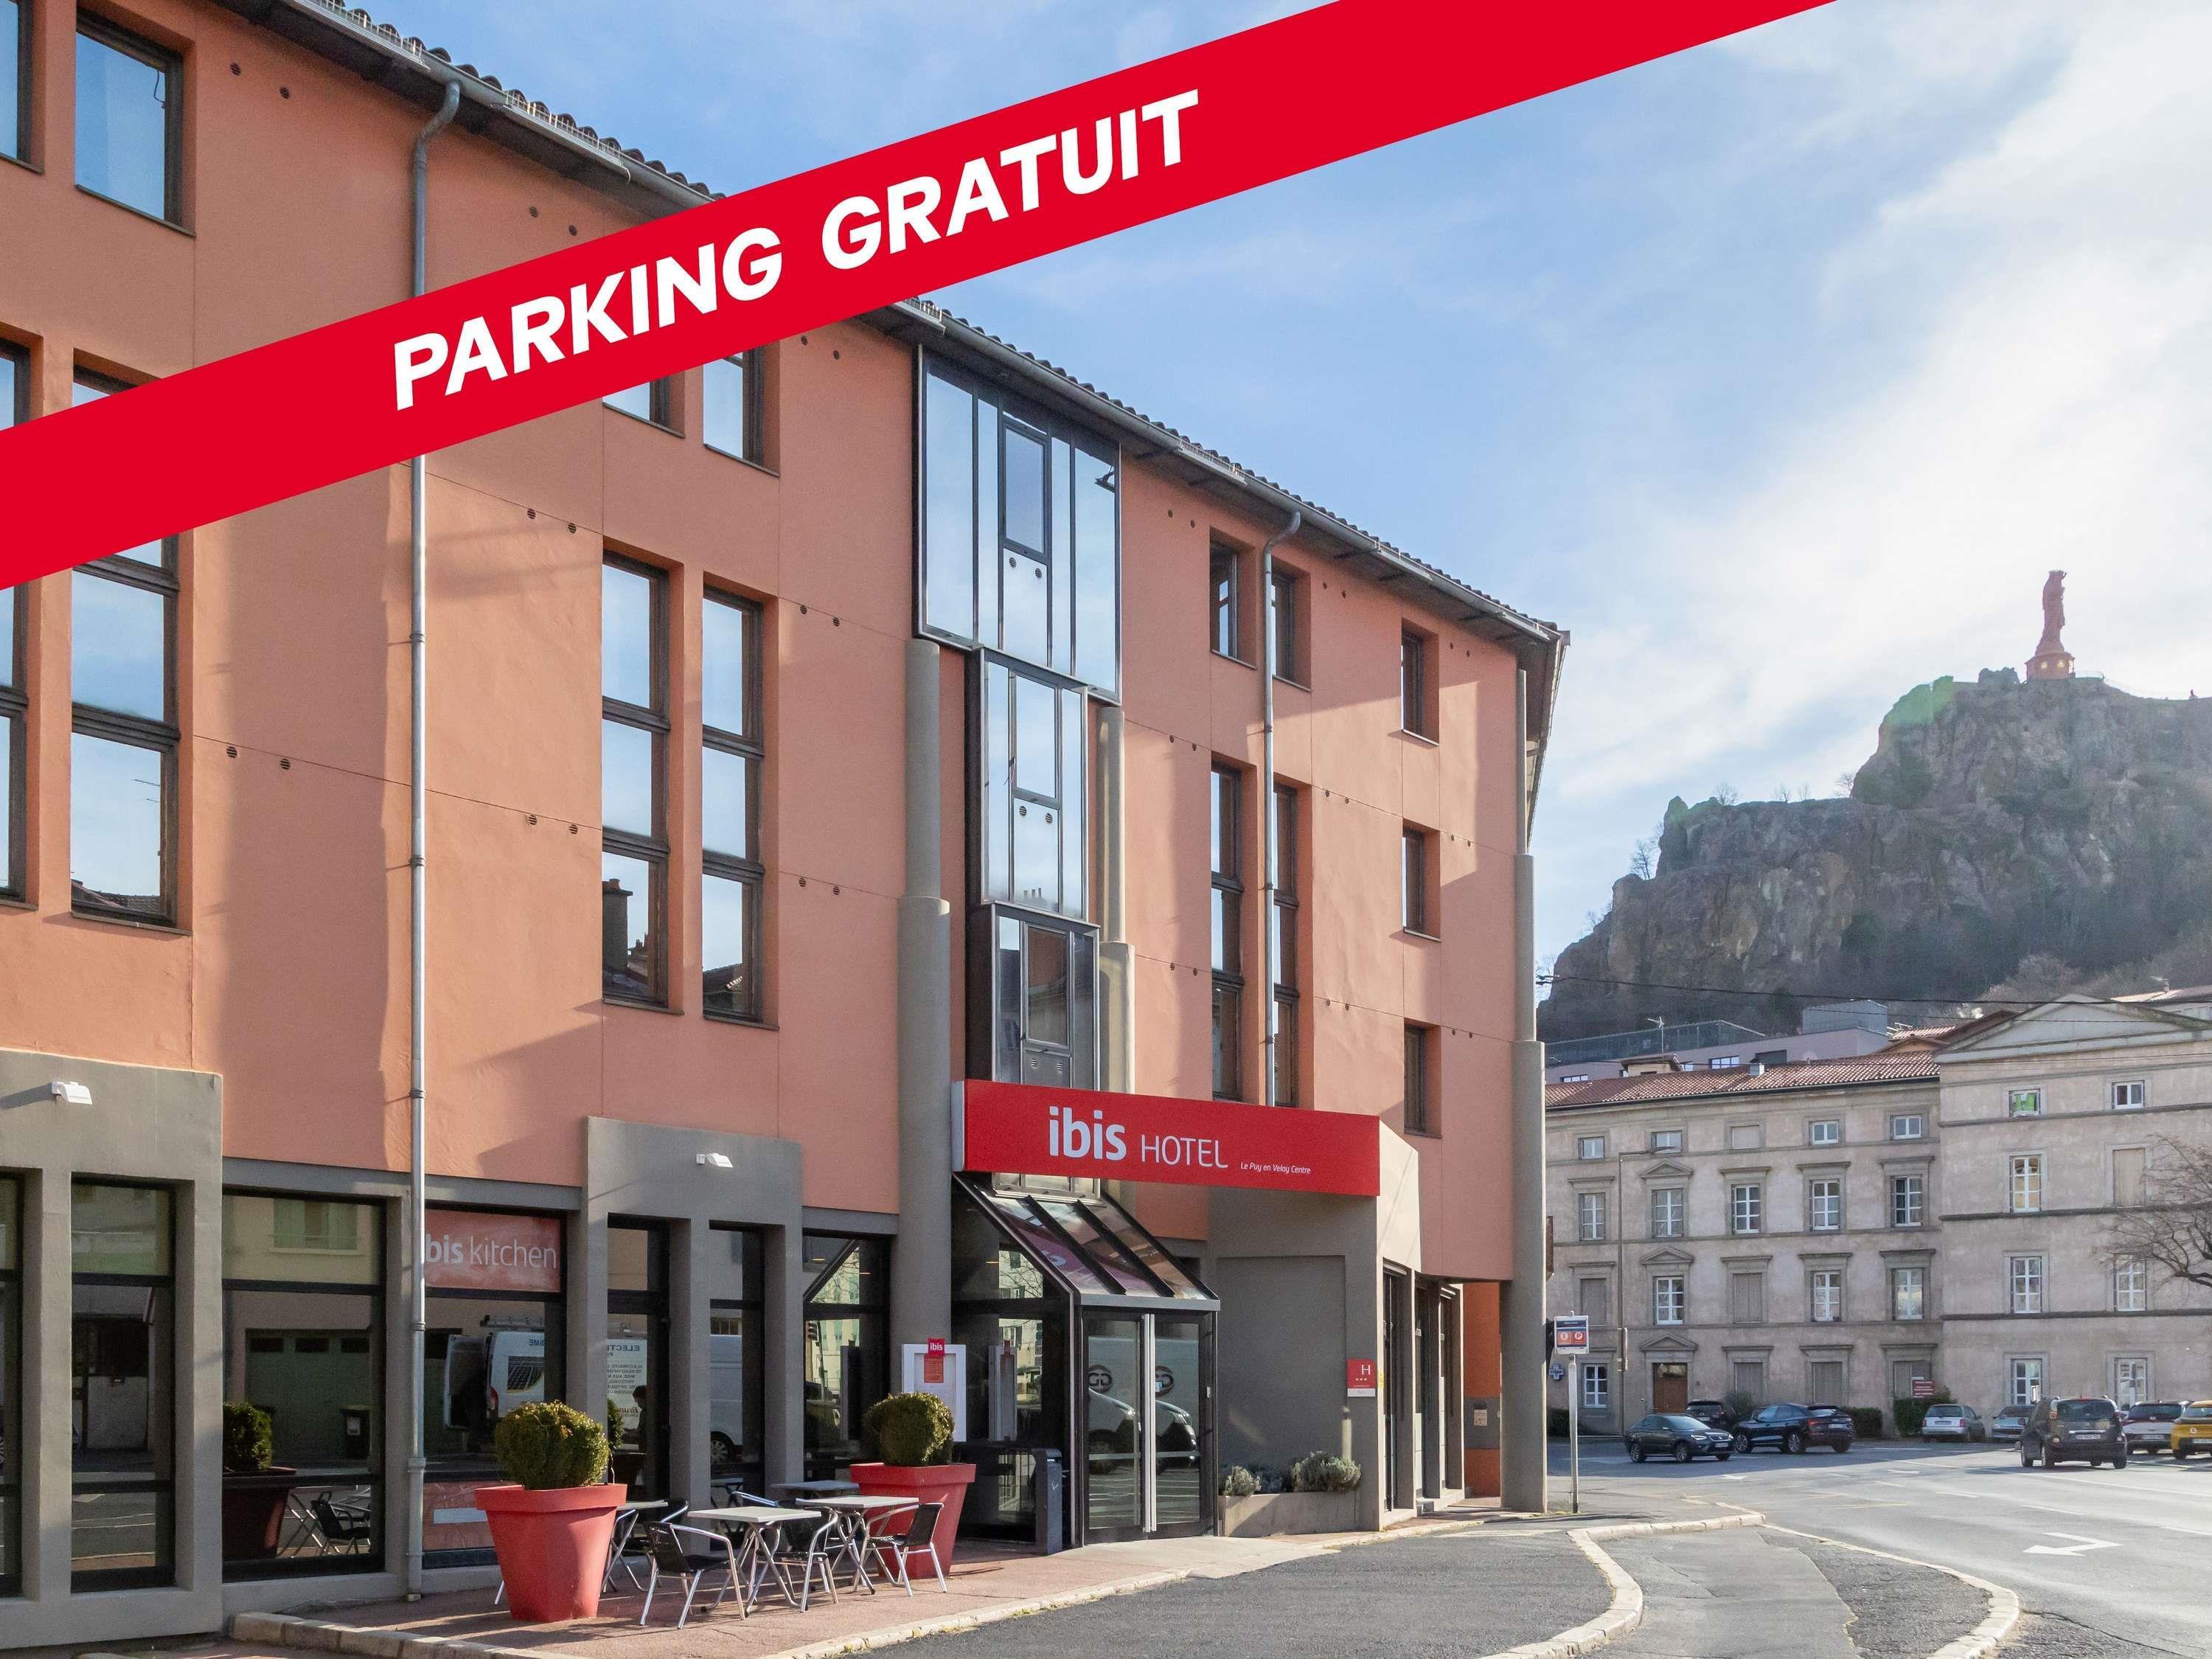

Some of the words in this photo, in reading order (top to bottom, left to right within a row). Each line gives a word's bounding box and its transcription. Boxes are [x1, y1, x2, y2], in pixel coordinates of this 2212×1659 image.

[1049, 1106, 1127, 1161] ibis
[1141, 1134, 1228, 1168] HOTEL
[1250, 1162, 1262, 1172] Puy
[1273, 1164, 1290, 1175] Velay
[1291, 1166, 1311, 1174] Centre
[425, 1234, 464, 1264] bis
[470, 1236, 557, 1269] kitchen
[930, 1343, 943, 1351] ibis
[1361, 1365, 1371, 1375] H
